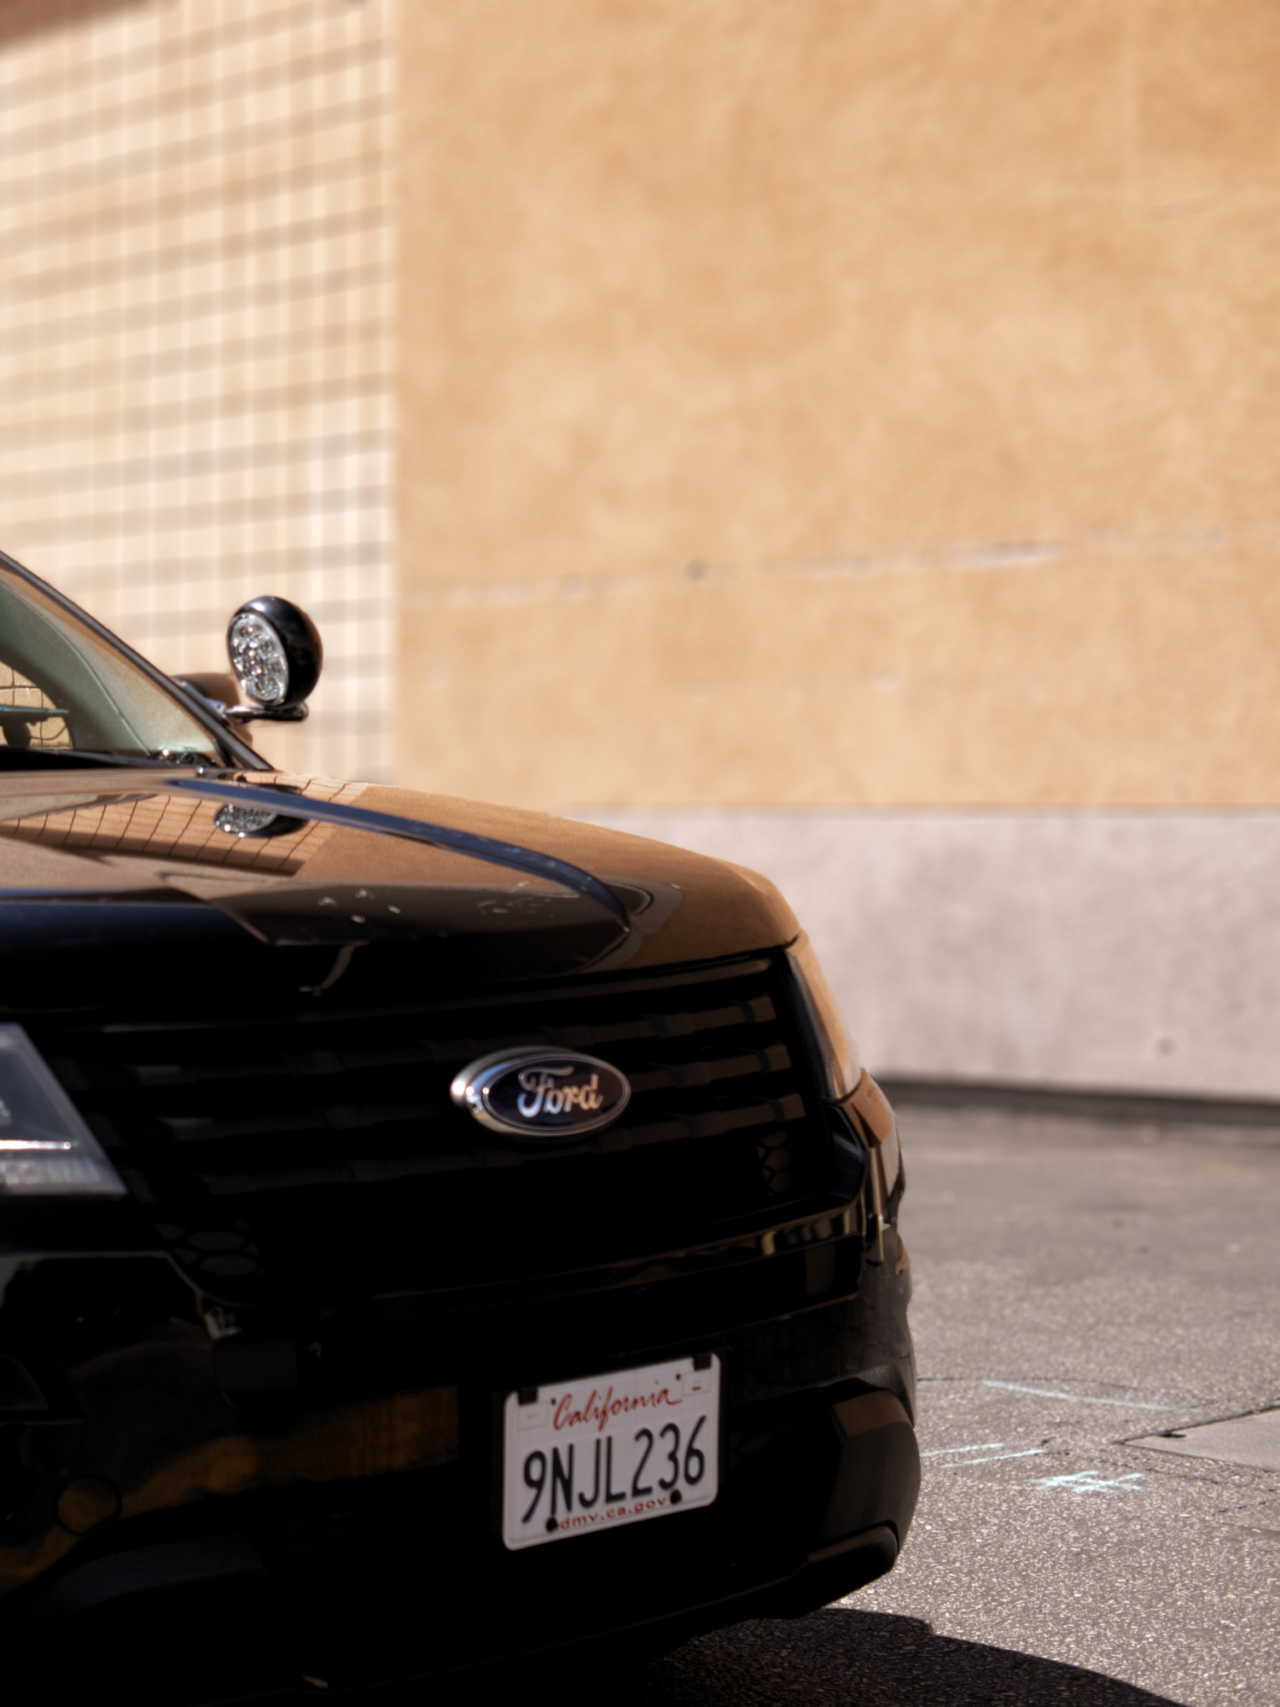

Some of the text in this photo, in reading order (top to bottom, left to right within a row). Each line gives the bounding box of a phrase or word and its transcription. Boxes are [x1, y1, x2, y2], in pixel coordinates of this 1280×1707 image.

[517, 1066, 603, 1118] Ford
[553, 1380, 684, 1432] California
[522, 1414, 707, 1524] 9NJL236
[560, 1496, 667, 1530] dmv.ca.gov
